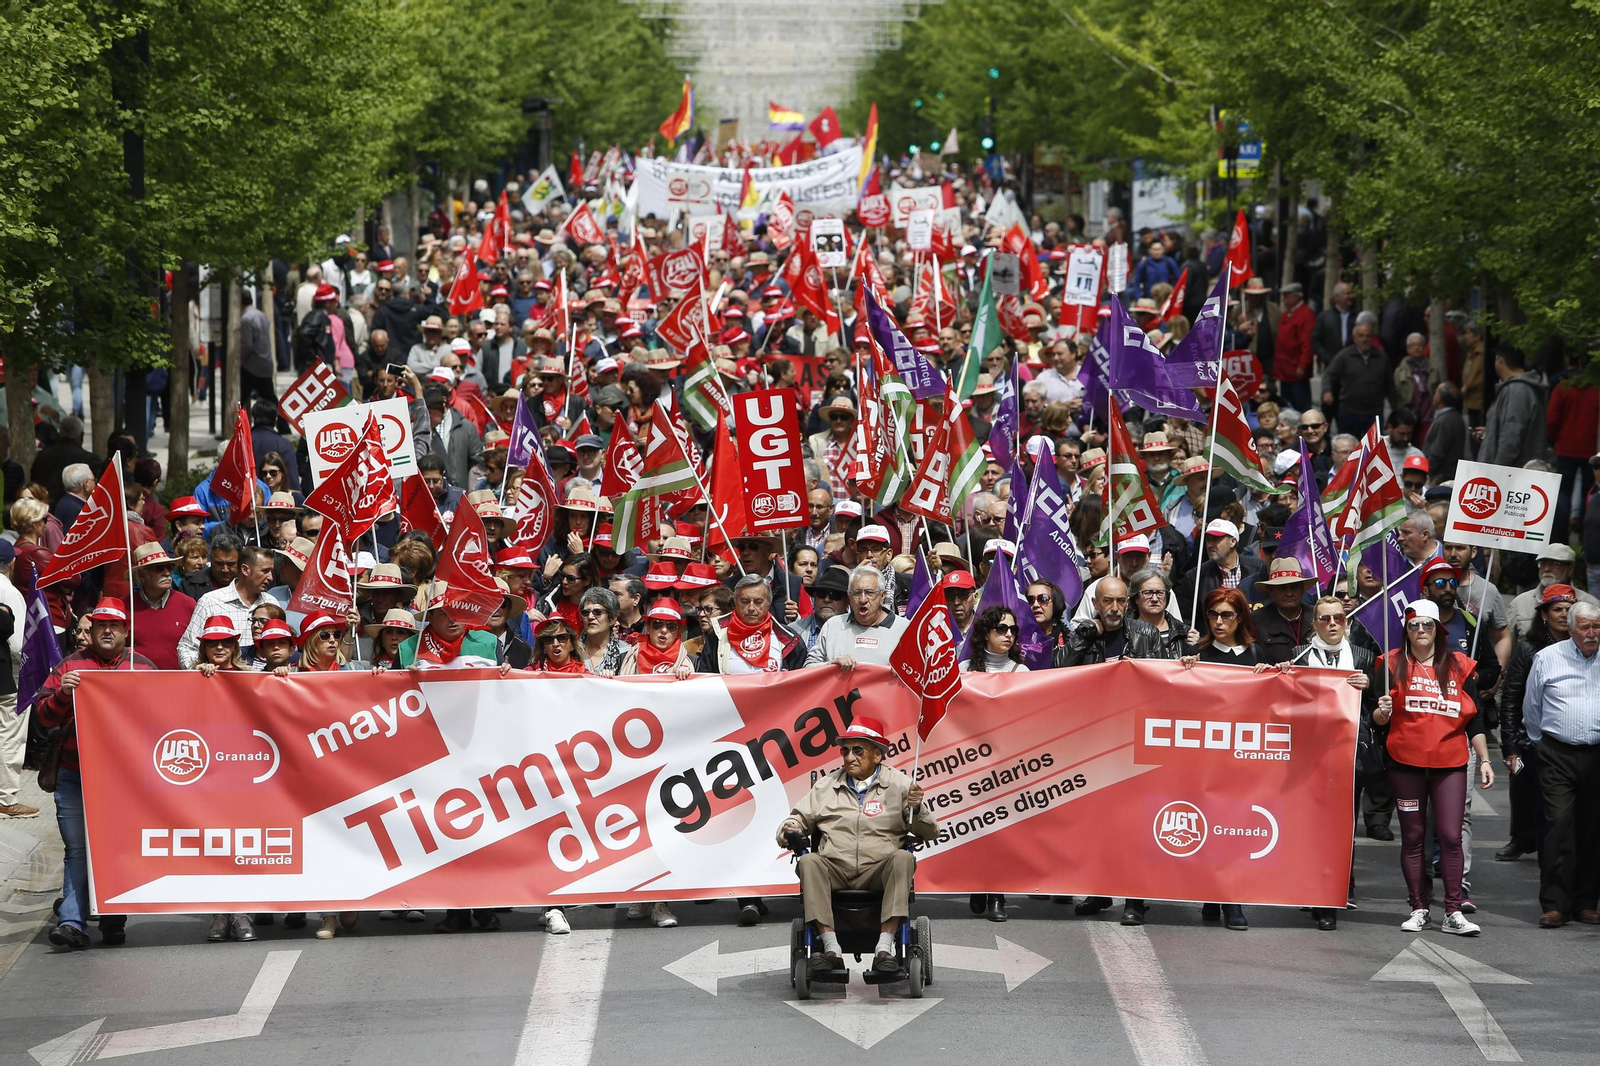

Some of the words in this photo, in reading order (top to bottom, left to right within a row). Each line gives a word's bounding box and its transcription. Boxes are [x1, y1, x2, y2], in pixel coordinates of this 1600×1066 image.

[320, 428, 352, 446] UGT
[745, 395, 791, 490] UGT
[1466, 483, 1497, 503] UGT
[1480, 526, 1516, 537] Andalucía
[307, 689, 427, 758] mayo
[162, 739, 201, 760] UGT
[215, 751, 270, 762] Granada
[660, 687, 863, 833] ganar
[1234, 750, 1291, 761] Granada
[911, 741, 993, 782] empleo
[968, 750, 1054, 797] salarios
[343, 707, 664, 872] Tiempo
[1013, 770, 1088, 813] dignas
[1161, 811, 1199, 833] UGT
[1213, 825, 1268, 837] Granada
[547, 801, 641, 873] de
[234, 855, 292, 866] Granada
